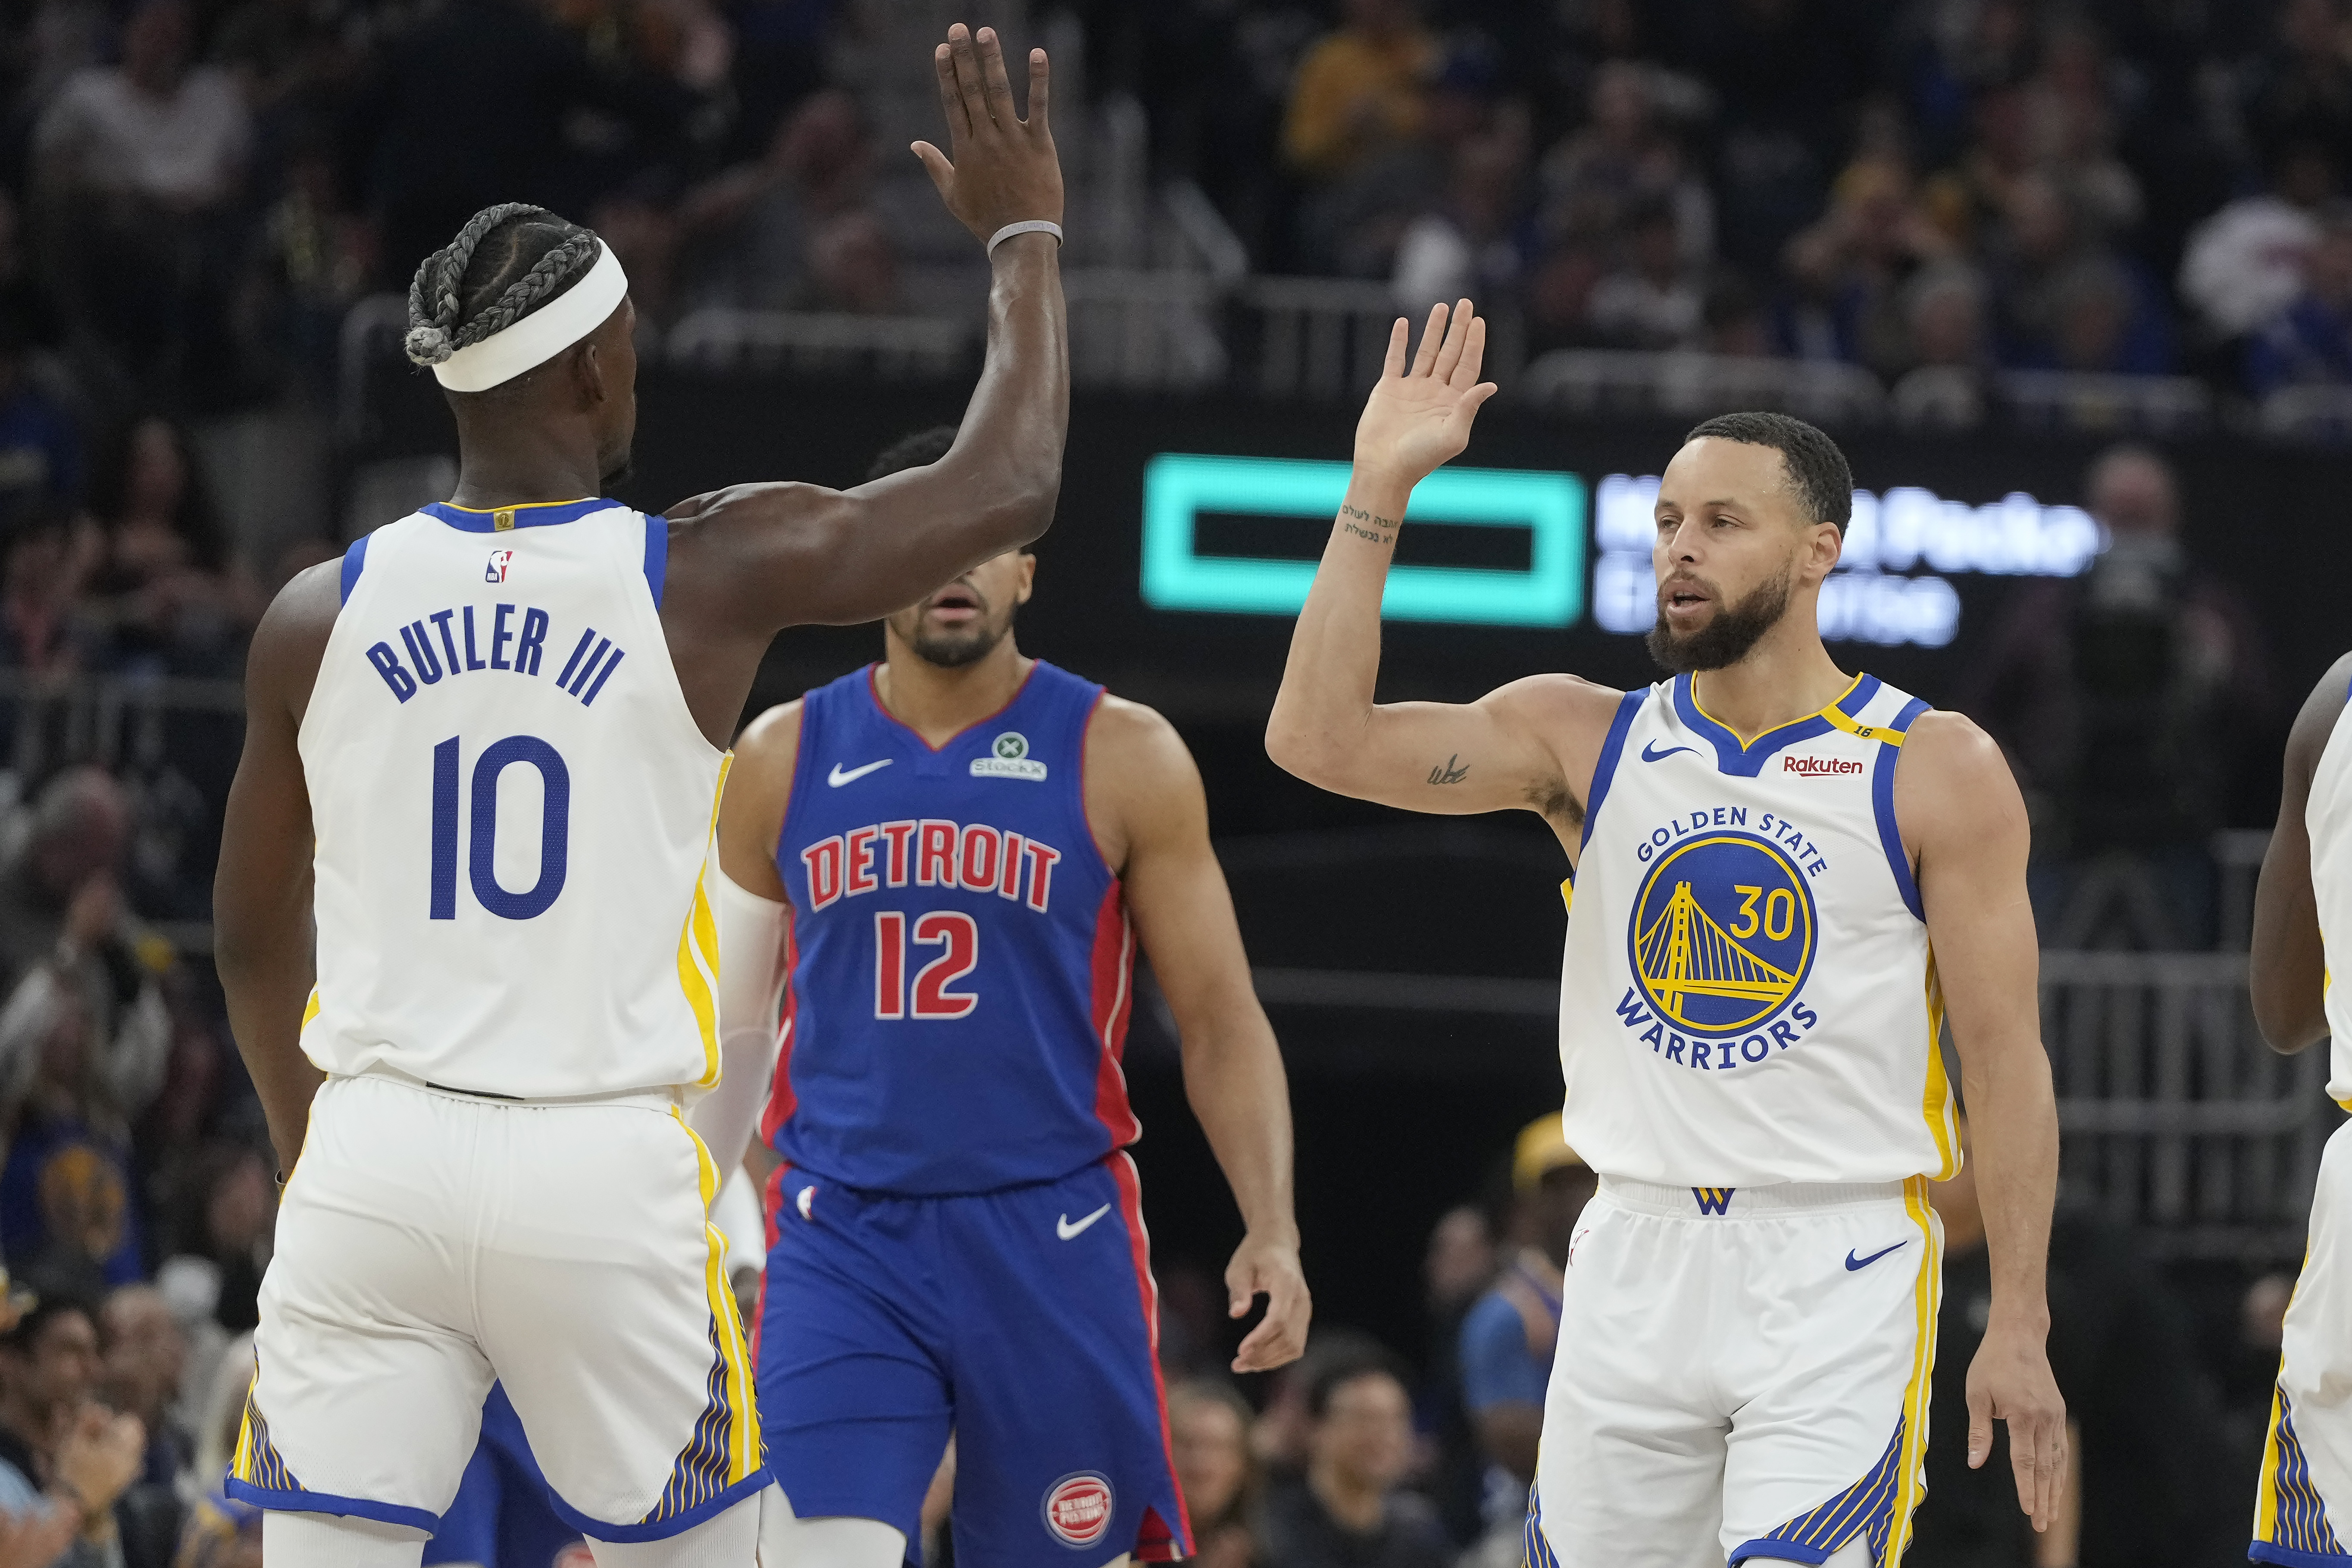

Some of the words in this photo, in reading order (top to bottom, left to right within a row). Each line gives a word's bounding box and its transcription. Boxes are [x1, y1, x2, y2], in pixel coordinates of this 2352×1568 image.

[487, 573, 497, 581] NBA
[366, 603, 549, 704] BUTLER
[556, 627, 626, 707] III
[1783, 756, 1863, 773] Rakuten
[1853, 726, 1873, 737] 16
[430, 735, 570, 920] 10
[801, 819, 1061, 913] DETROIT
[1637, 807, 1747, 861] GOLDEN
[1759, 813, 1827, 877] STATE
[1730, 884, 1795, 941] 30
[874, 911, 979, 1020] 12
[1615, 986, 1817, 1070] WARRIORS
